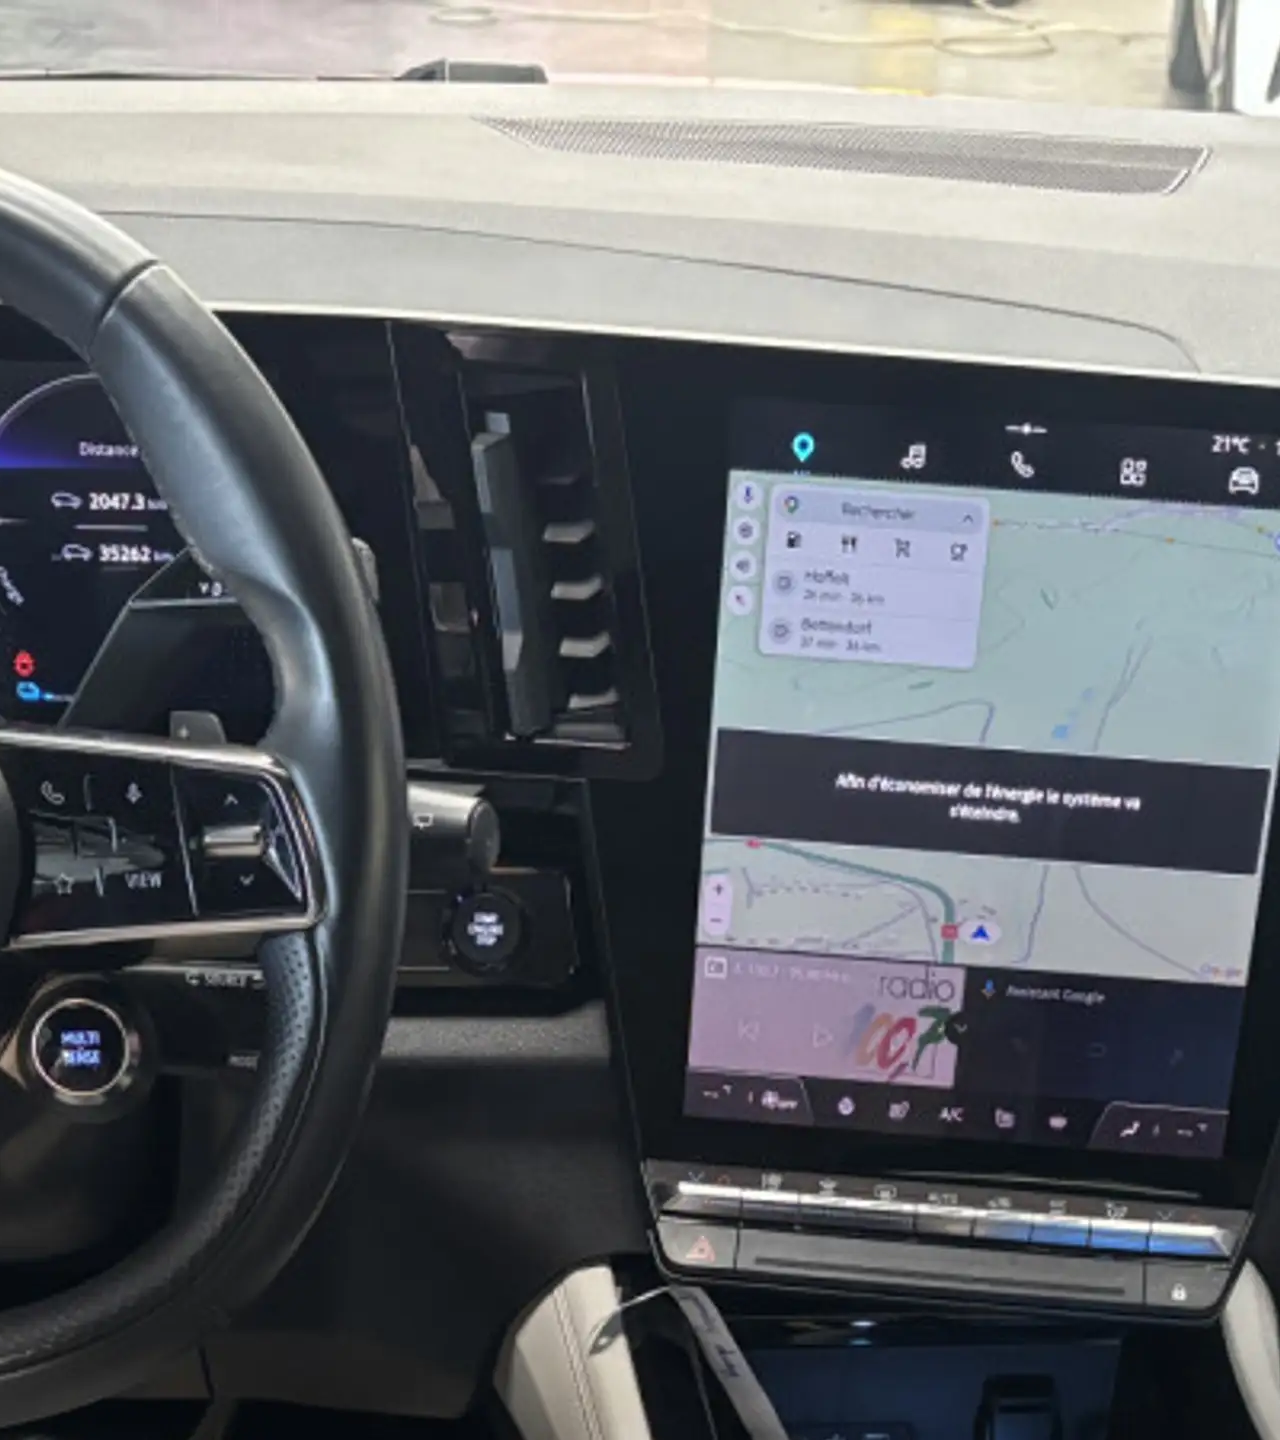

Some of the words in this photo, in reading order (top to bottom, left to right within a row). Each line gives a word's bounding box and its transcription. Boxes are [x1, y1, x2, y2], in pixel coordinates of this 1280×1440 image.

[78, 441, 139, 457] Distance
[88, 492, 146, 511] 2047.3
[98, 544, 151, 563] 35262
[835, 772, 865, 790] Afin
[867, 774, 961, 798] d'économiser
[963, 782, 983, 799] de
[1046, 788, 1061, 805] le
[124, 871, 162, 889] VIEW
[878, 964, 956, 1002] radio
